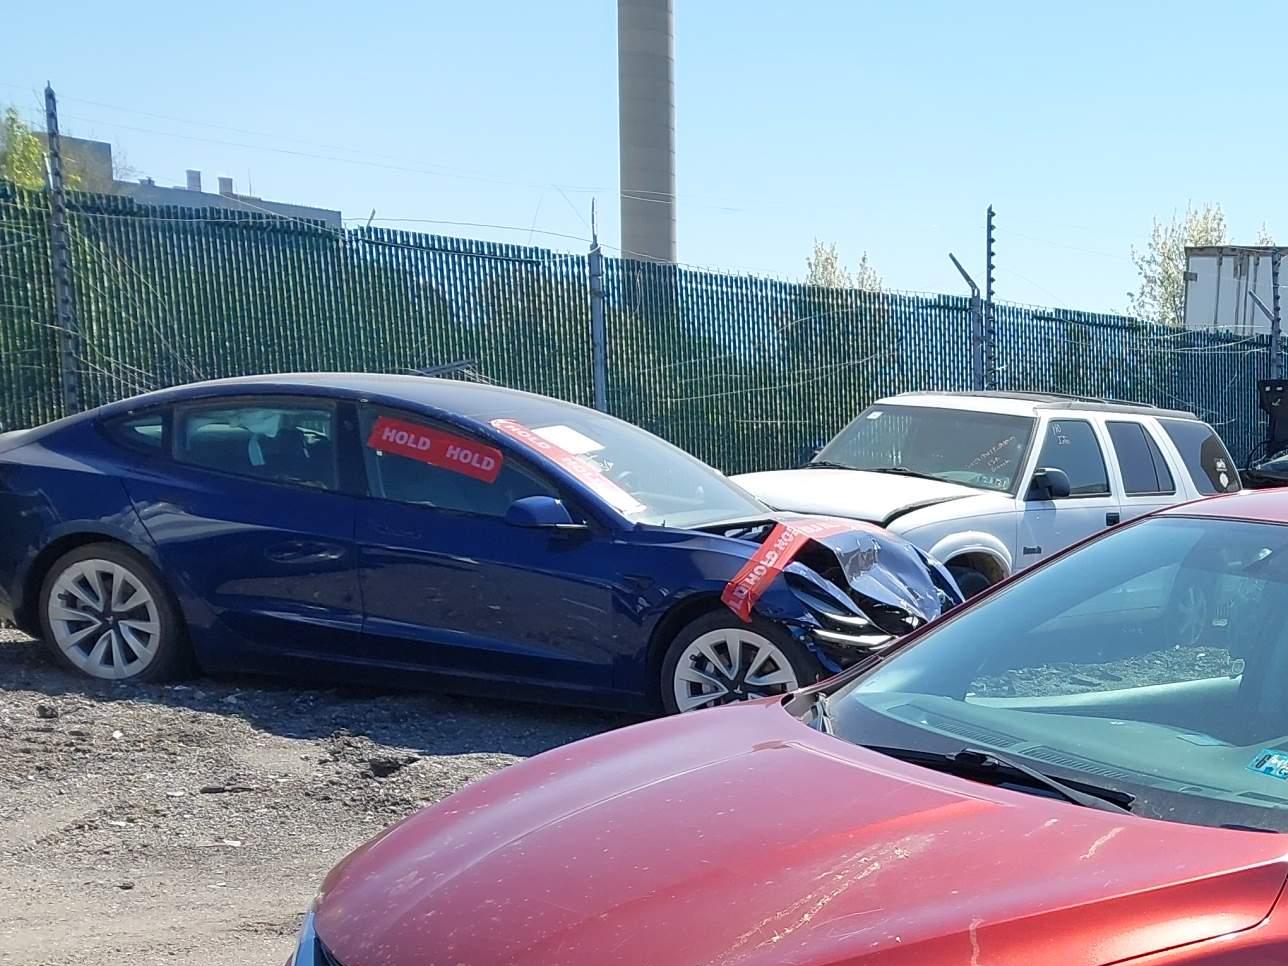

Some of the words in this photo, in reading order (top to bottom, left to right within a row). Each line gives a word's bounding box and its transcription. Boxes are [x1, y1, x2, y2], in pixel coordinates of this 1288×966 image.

[382, 427, 431, 450] HOLD
[446, 445, 495, 471] HOLD
[504, 424, 551, 449] HOLD
[744, 550, 779, 586] HOLD
[1255, 754, 1272, 769] 6
